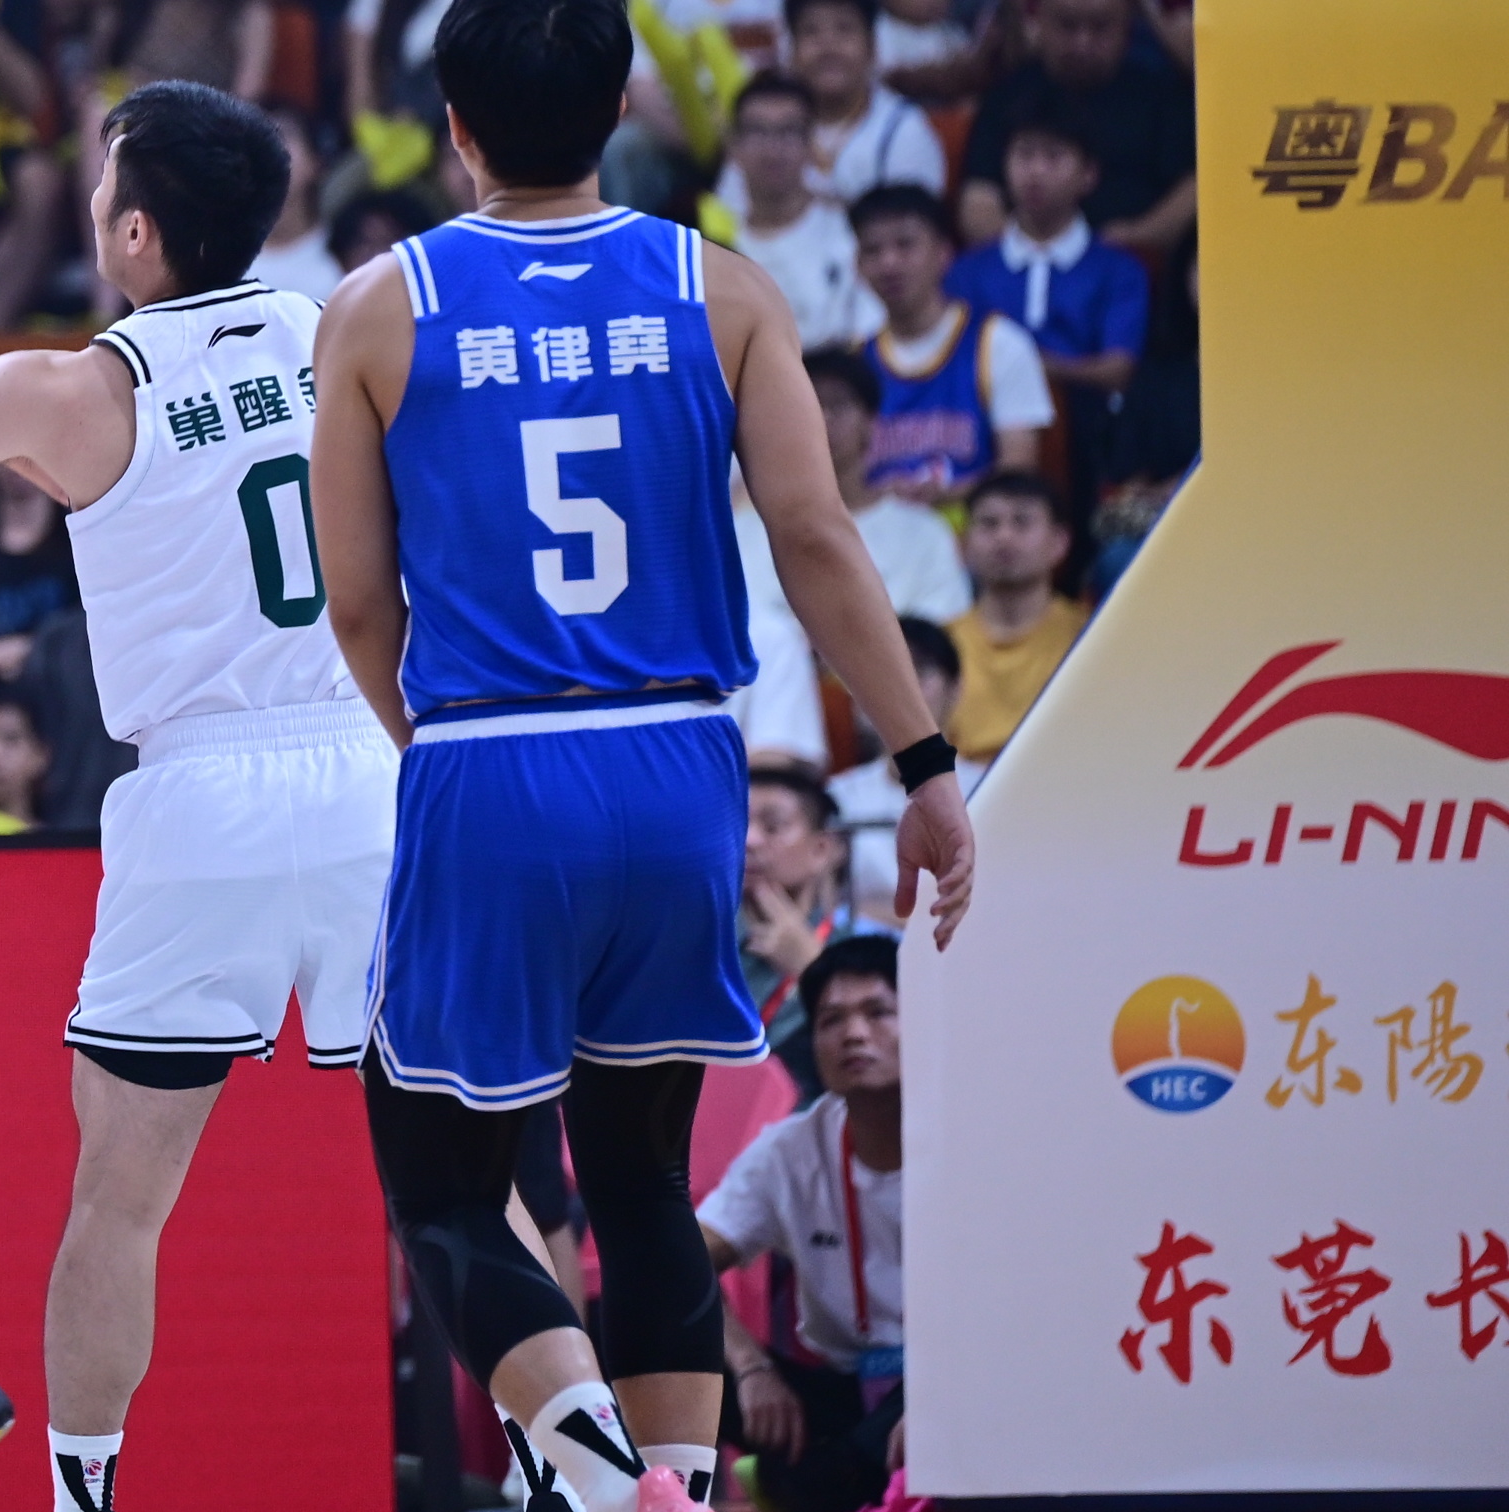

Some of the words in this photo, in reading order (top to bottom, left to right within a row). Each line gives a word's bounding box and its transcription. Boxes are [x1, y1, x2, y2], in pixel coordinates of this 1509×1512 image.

[236, 452, 328, 628] 0
[519, 413, 630, 616] 5
[1150, 1075, 1208, 1103] HEC
[1264, 971, 1509, 1109] 东陽
